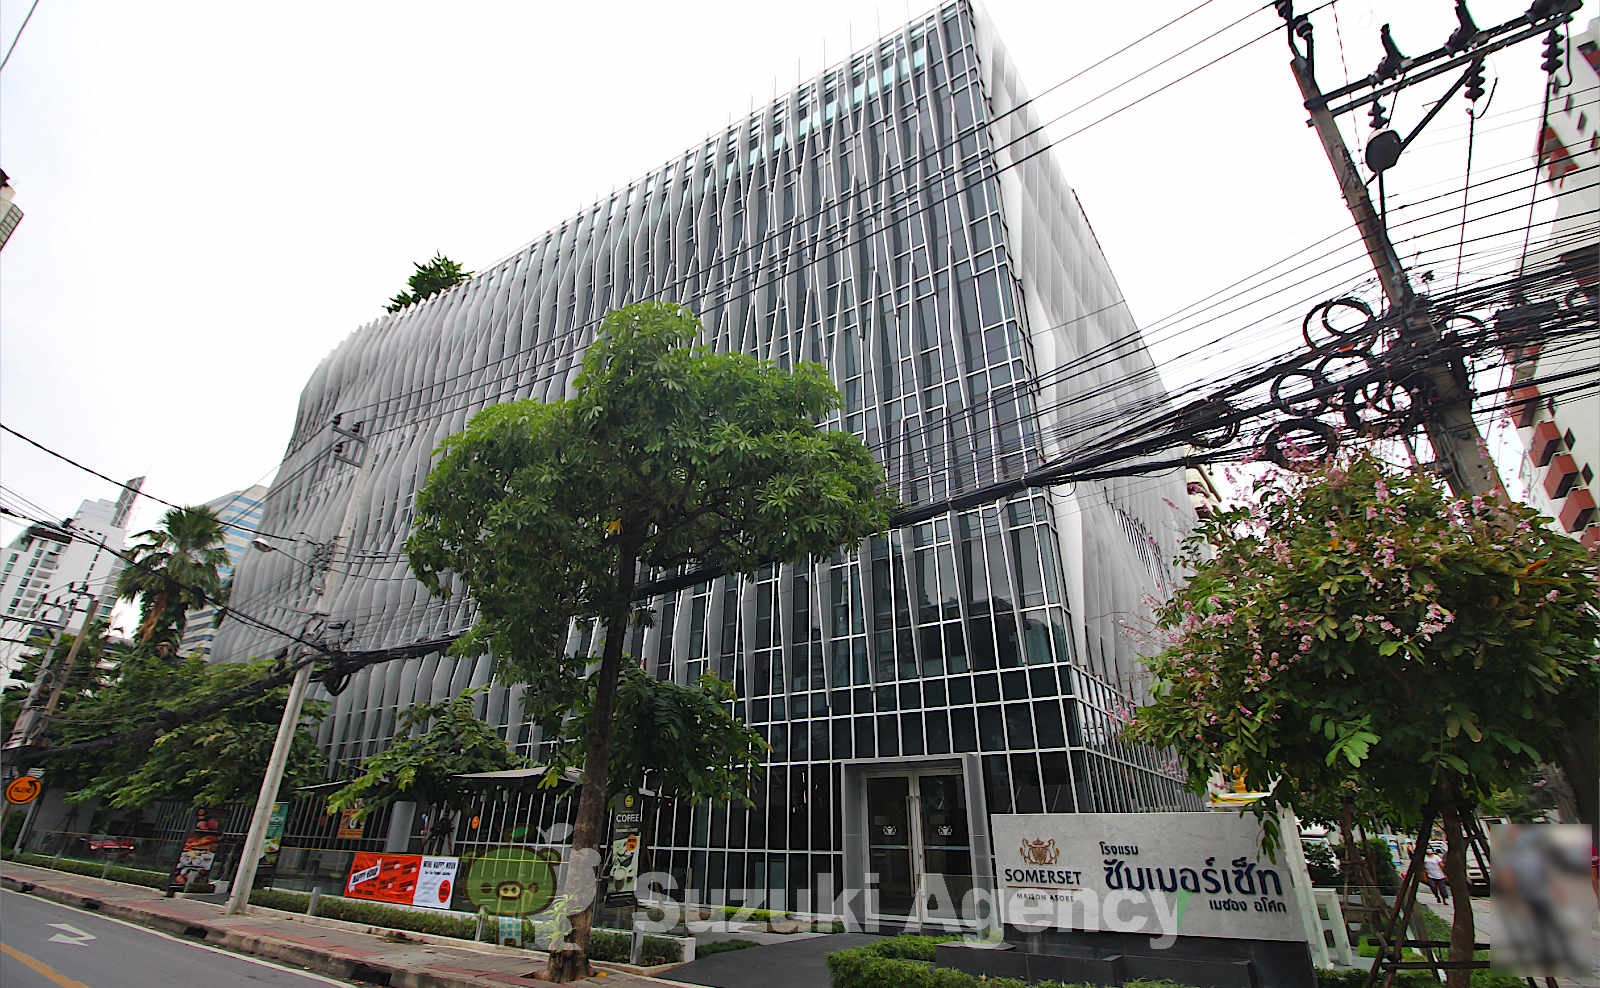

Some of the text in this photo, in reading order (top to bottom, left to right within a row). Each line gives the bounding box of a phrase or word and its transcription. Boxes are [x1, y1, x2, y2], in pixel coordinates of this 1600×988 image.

[1099, 841, 1140, 856] โรงแรม
[1004, 868, 1082, 886] SOMERSET
